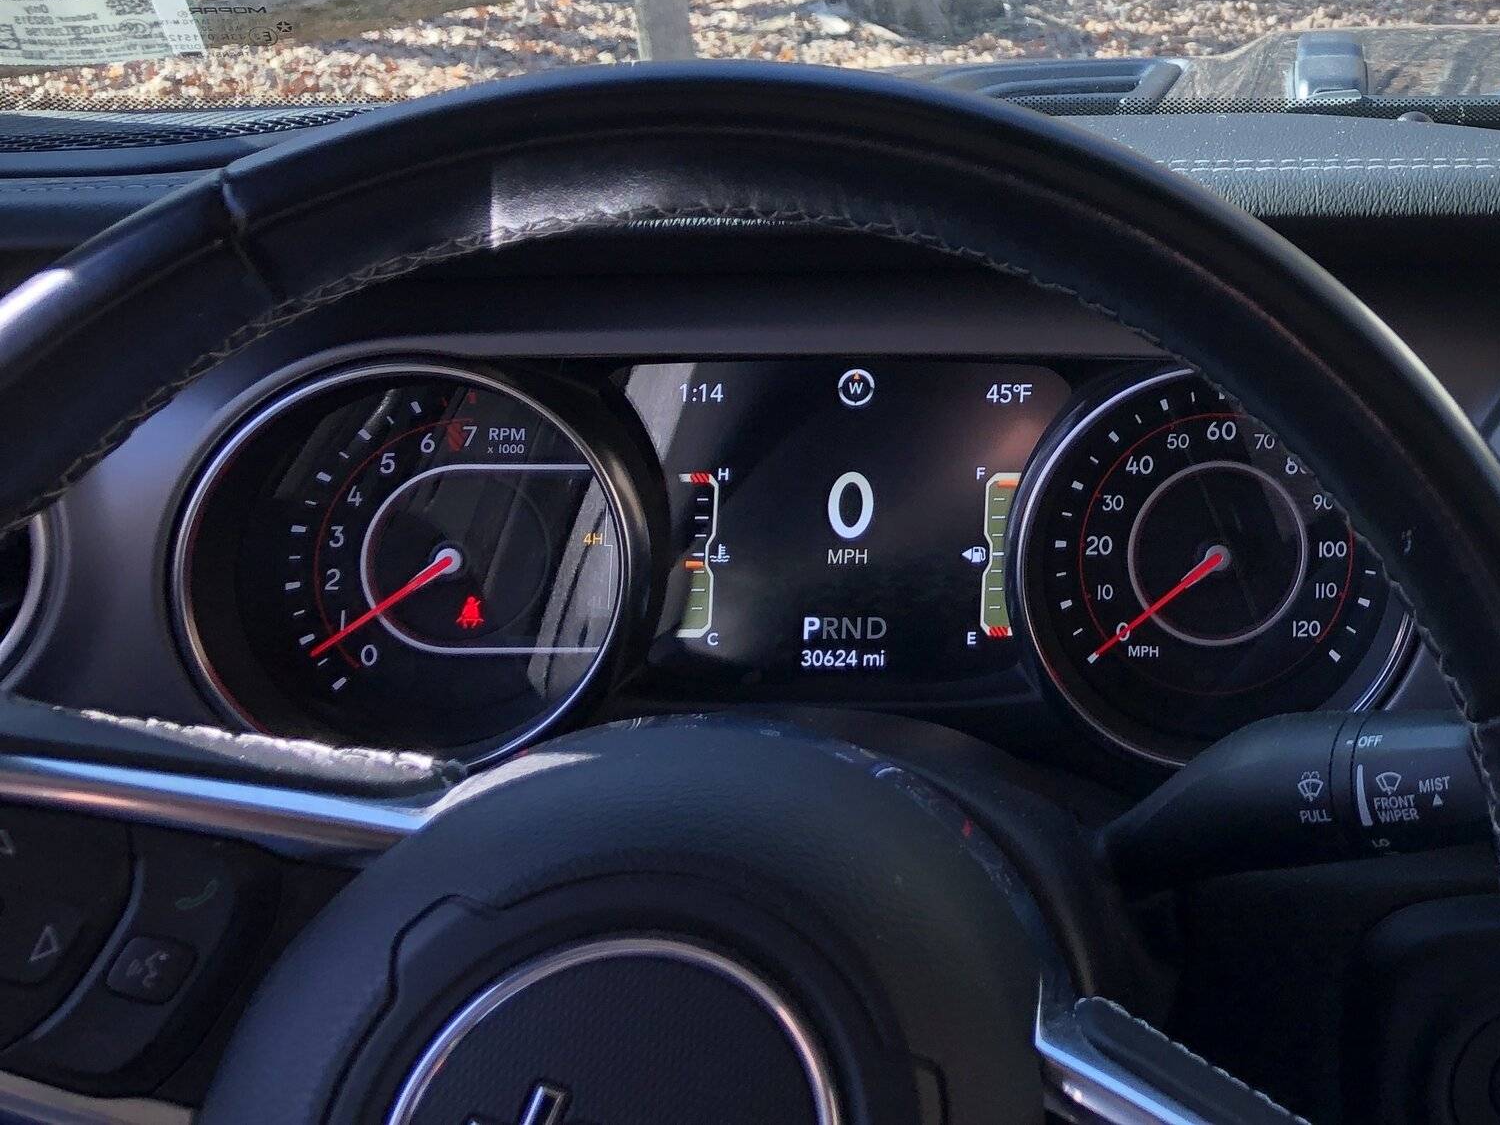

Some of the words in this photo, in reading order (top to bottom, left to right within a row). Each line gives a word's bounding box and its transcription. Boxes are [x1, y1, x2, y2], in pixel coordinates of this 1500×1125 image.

[678, 382, 724, 403] 1:14
[849, 382, 863, 395] W
[987, 384, 1032, 403] 45°F
[462, 425, 477, 447] 7
[489, 428, 525, 441] RPM
[1207, 421, 1236, 440] 60
[421, 433, 435, 453] 6
[499, 444, 524, 453] 1000
[1167, 434, 1189, 449] 50
[1253, 433, 1276, 450] 70
[380, 453, 395, 473] 5
[1126, 456, 1153, 474] 40
[1285, 456, 1306, 475] 8
[718, 468, 730, 481] H
[977, 467, 985, 479] F
[347, 486, 362, 506] 4
[1103, 495, 1124, 511] 30
[828, 472, 874, 539] 0
[330, 526, 344, 547] 3
[583, 532, 603, 546] 4H
[1086, 536, 1112, 555] 20
[1319, 541, 1347, 557] 100
[828, 549, 867, 564] MPH
[325, 569, 340, 590] 2
[1098, 585, 1113, 600] 10
[1316, 583, 1337, 598] 110
[1293, 621, 1320, 637] 120
[708, 632, 719, 646] C
[967, 632, 976, 644] E
[361, 645, 377, 666] 0
[801, 650, 857, 666] 30624
[863, 650, 884, 666] mi
[1129, 646, 1158, 657] MPH
[1357, 734, 1383, 747] OFF
[1419, 776, 1450, 793] MIST
[1373, 794, 1415, 810] FRONT
[1300, 809, 1331, 823] PULL
[1376, 808, 1419, 823] WIPER
